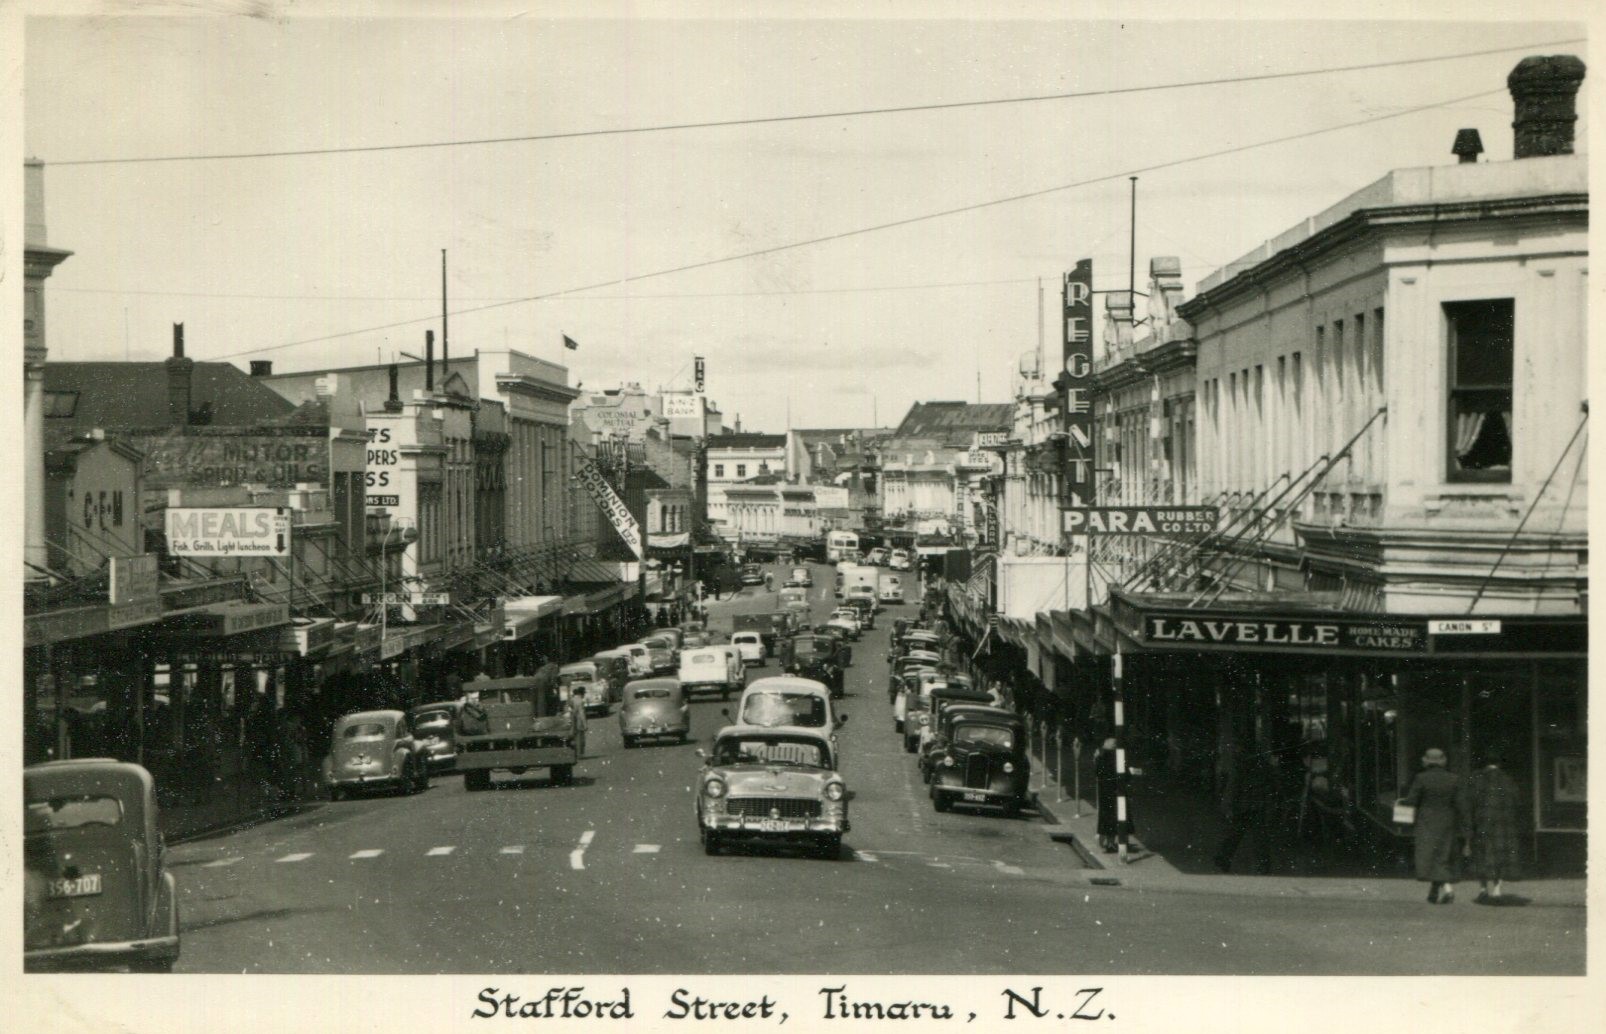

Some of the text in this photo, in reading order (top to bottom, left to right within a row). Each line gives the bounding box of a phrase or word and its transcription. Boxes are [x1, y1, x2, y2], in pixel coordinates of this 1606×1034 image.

[1066, 281, 1092, 484] REGENT
[223, 444, 309, 462] MOTOR
[367, 450, 398, 465] PERS
[255, 469, 265, 481] &
[273, 464, 318, 481] OILS
[577, 469, 623, 528] MOTORS
[584, 464, 636, 528] DOMINION
[172, 512, 270, 538] MEALS
[1063, 511, 1214, 532] PARA RUBBER
[1162, 523, 1181, 532] CO
[217, 540, 235, 554] Light
[237, 540, 271, 551] luncheon
[1152, 619, 1340, 645] LAVELLE
[1350, 627, 1418, 638] HOME MADE
[1438, 622, 1472, 631] CANON
[1355, 636, 1412, 648] CAKES
